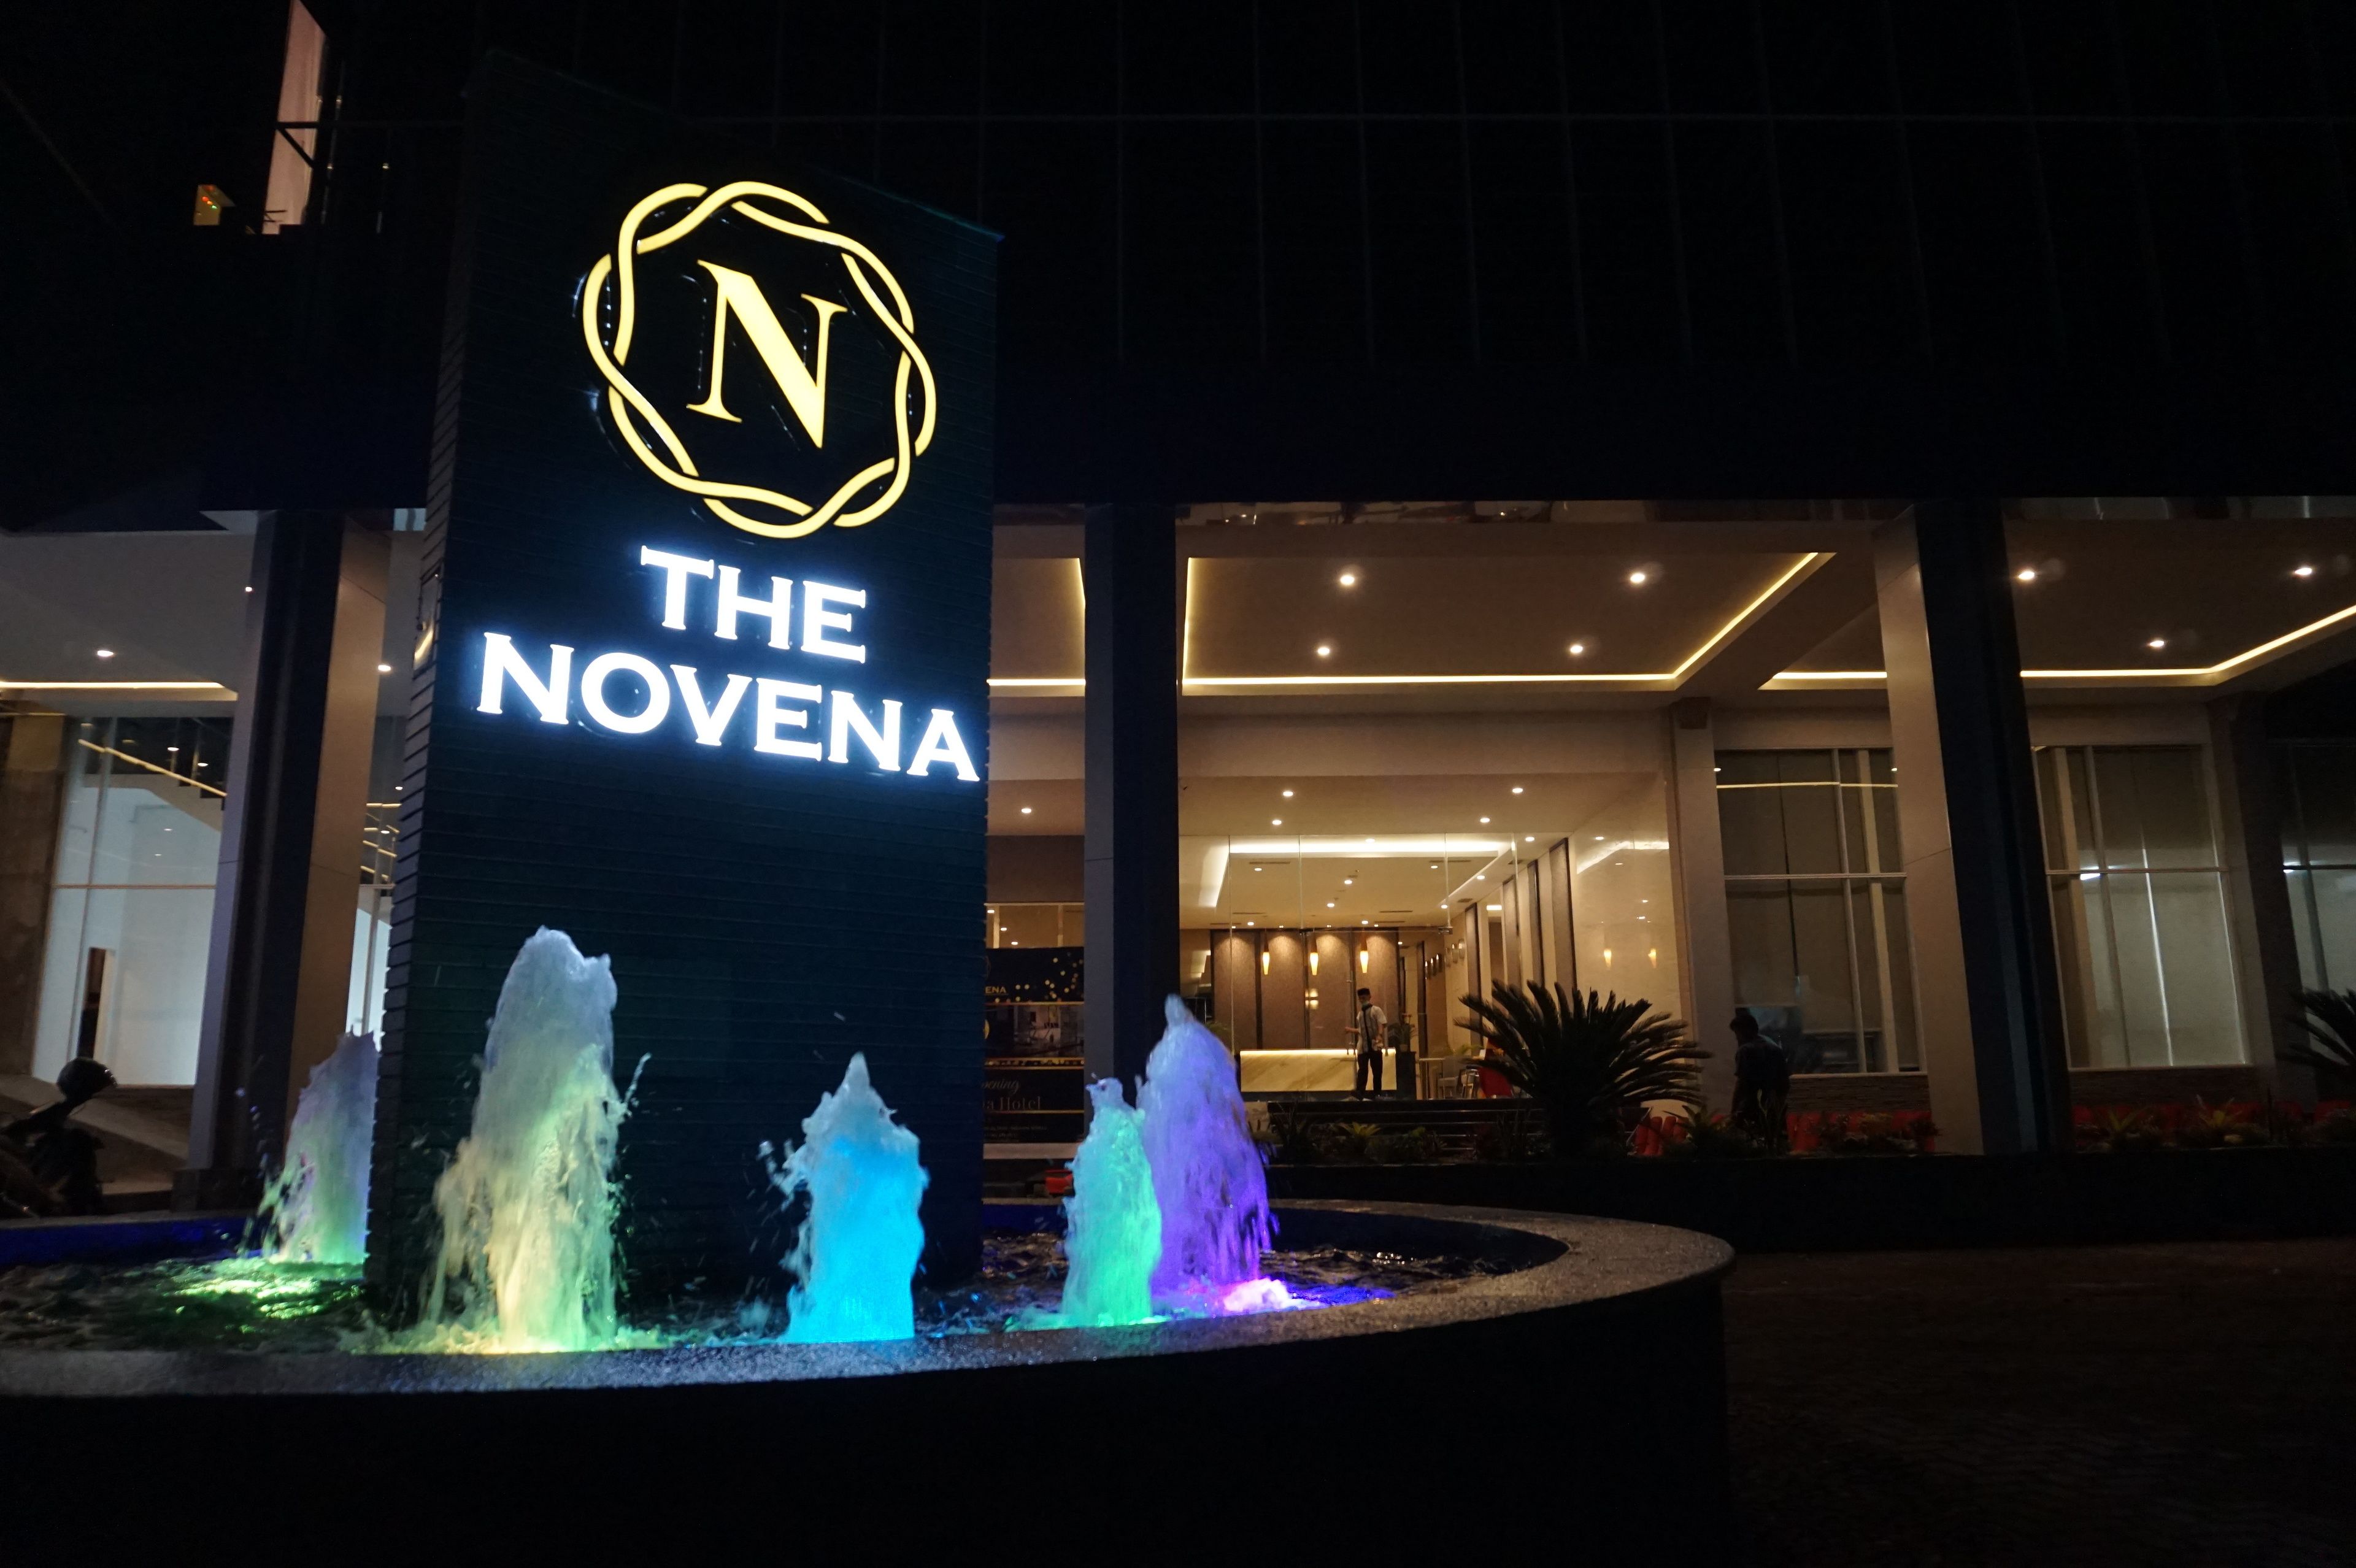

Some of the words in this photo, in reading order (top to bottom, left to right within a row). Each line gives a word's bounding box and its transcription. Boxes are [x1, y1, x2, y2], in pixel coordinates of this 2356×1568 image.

[686, 259, 848, 449] N
[640, 545, 866, 664] THE
[476, 632, 980, 782] NOVENA
[999, 1096, 1041, 1110] Hotel
